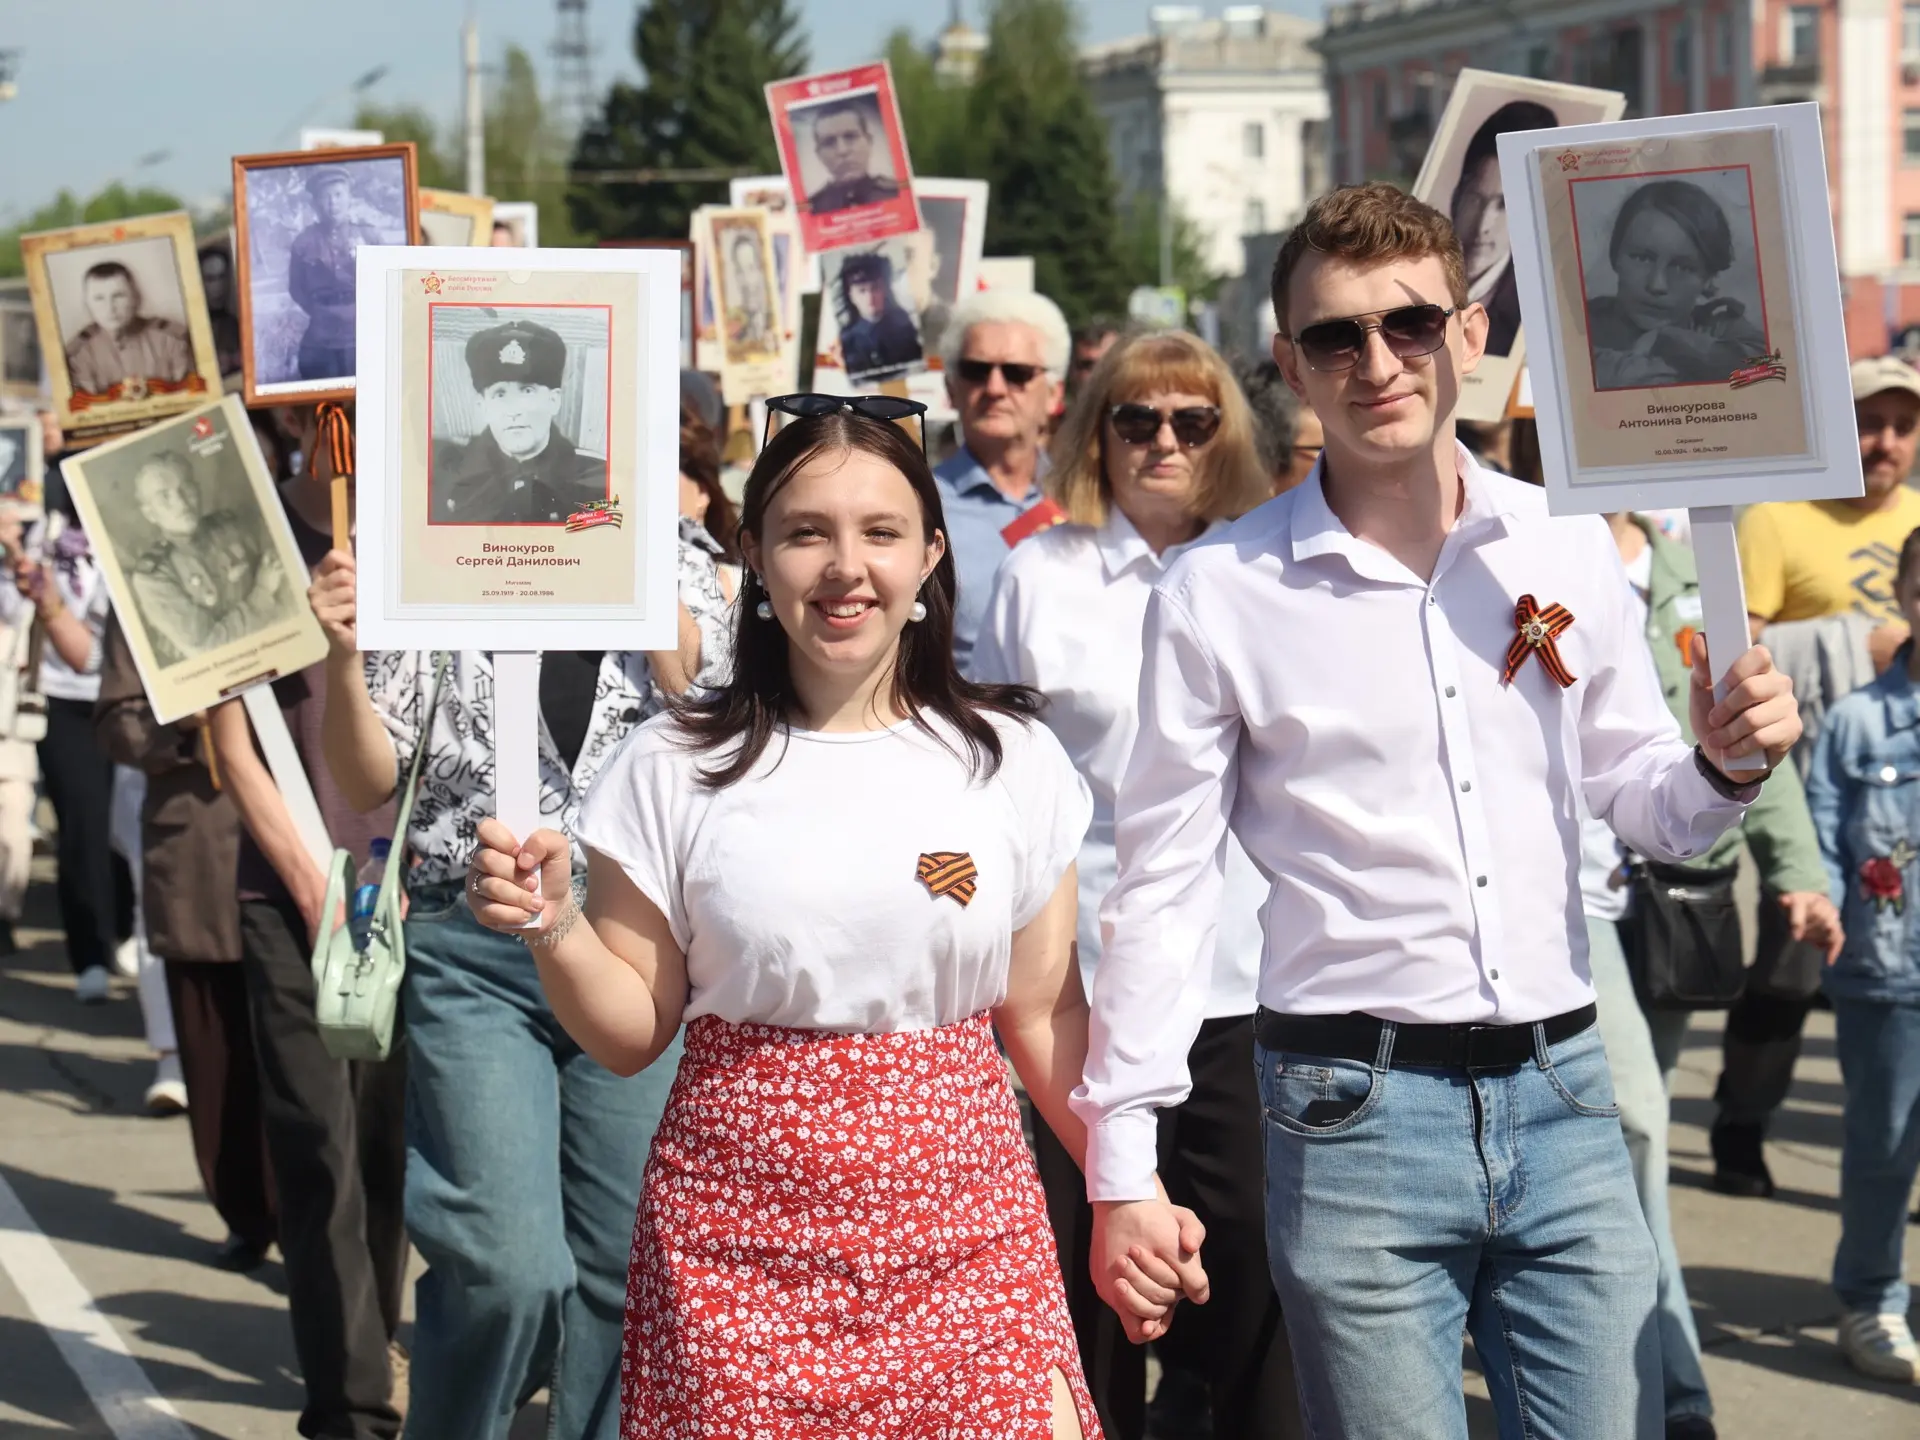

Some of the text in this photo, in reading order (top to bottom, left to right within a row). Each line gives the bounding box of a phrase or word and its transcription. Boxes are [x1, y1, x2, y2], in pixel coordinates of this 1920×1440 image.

[1647, 401, 1726, 414] Винокурова
[1618, 412, 1758, 429] Антонина Романовна
[482, 542, 555, 555] Винокуров
[456, 555, 581, 568] Сергей Данилович
